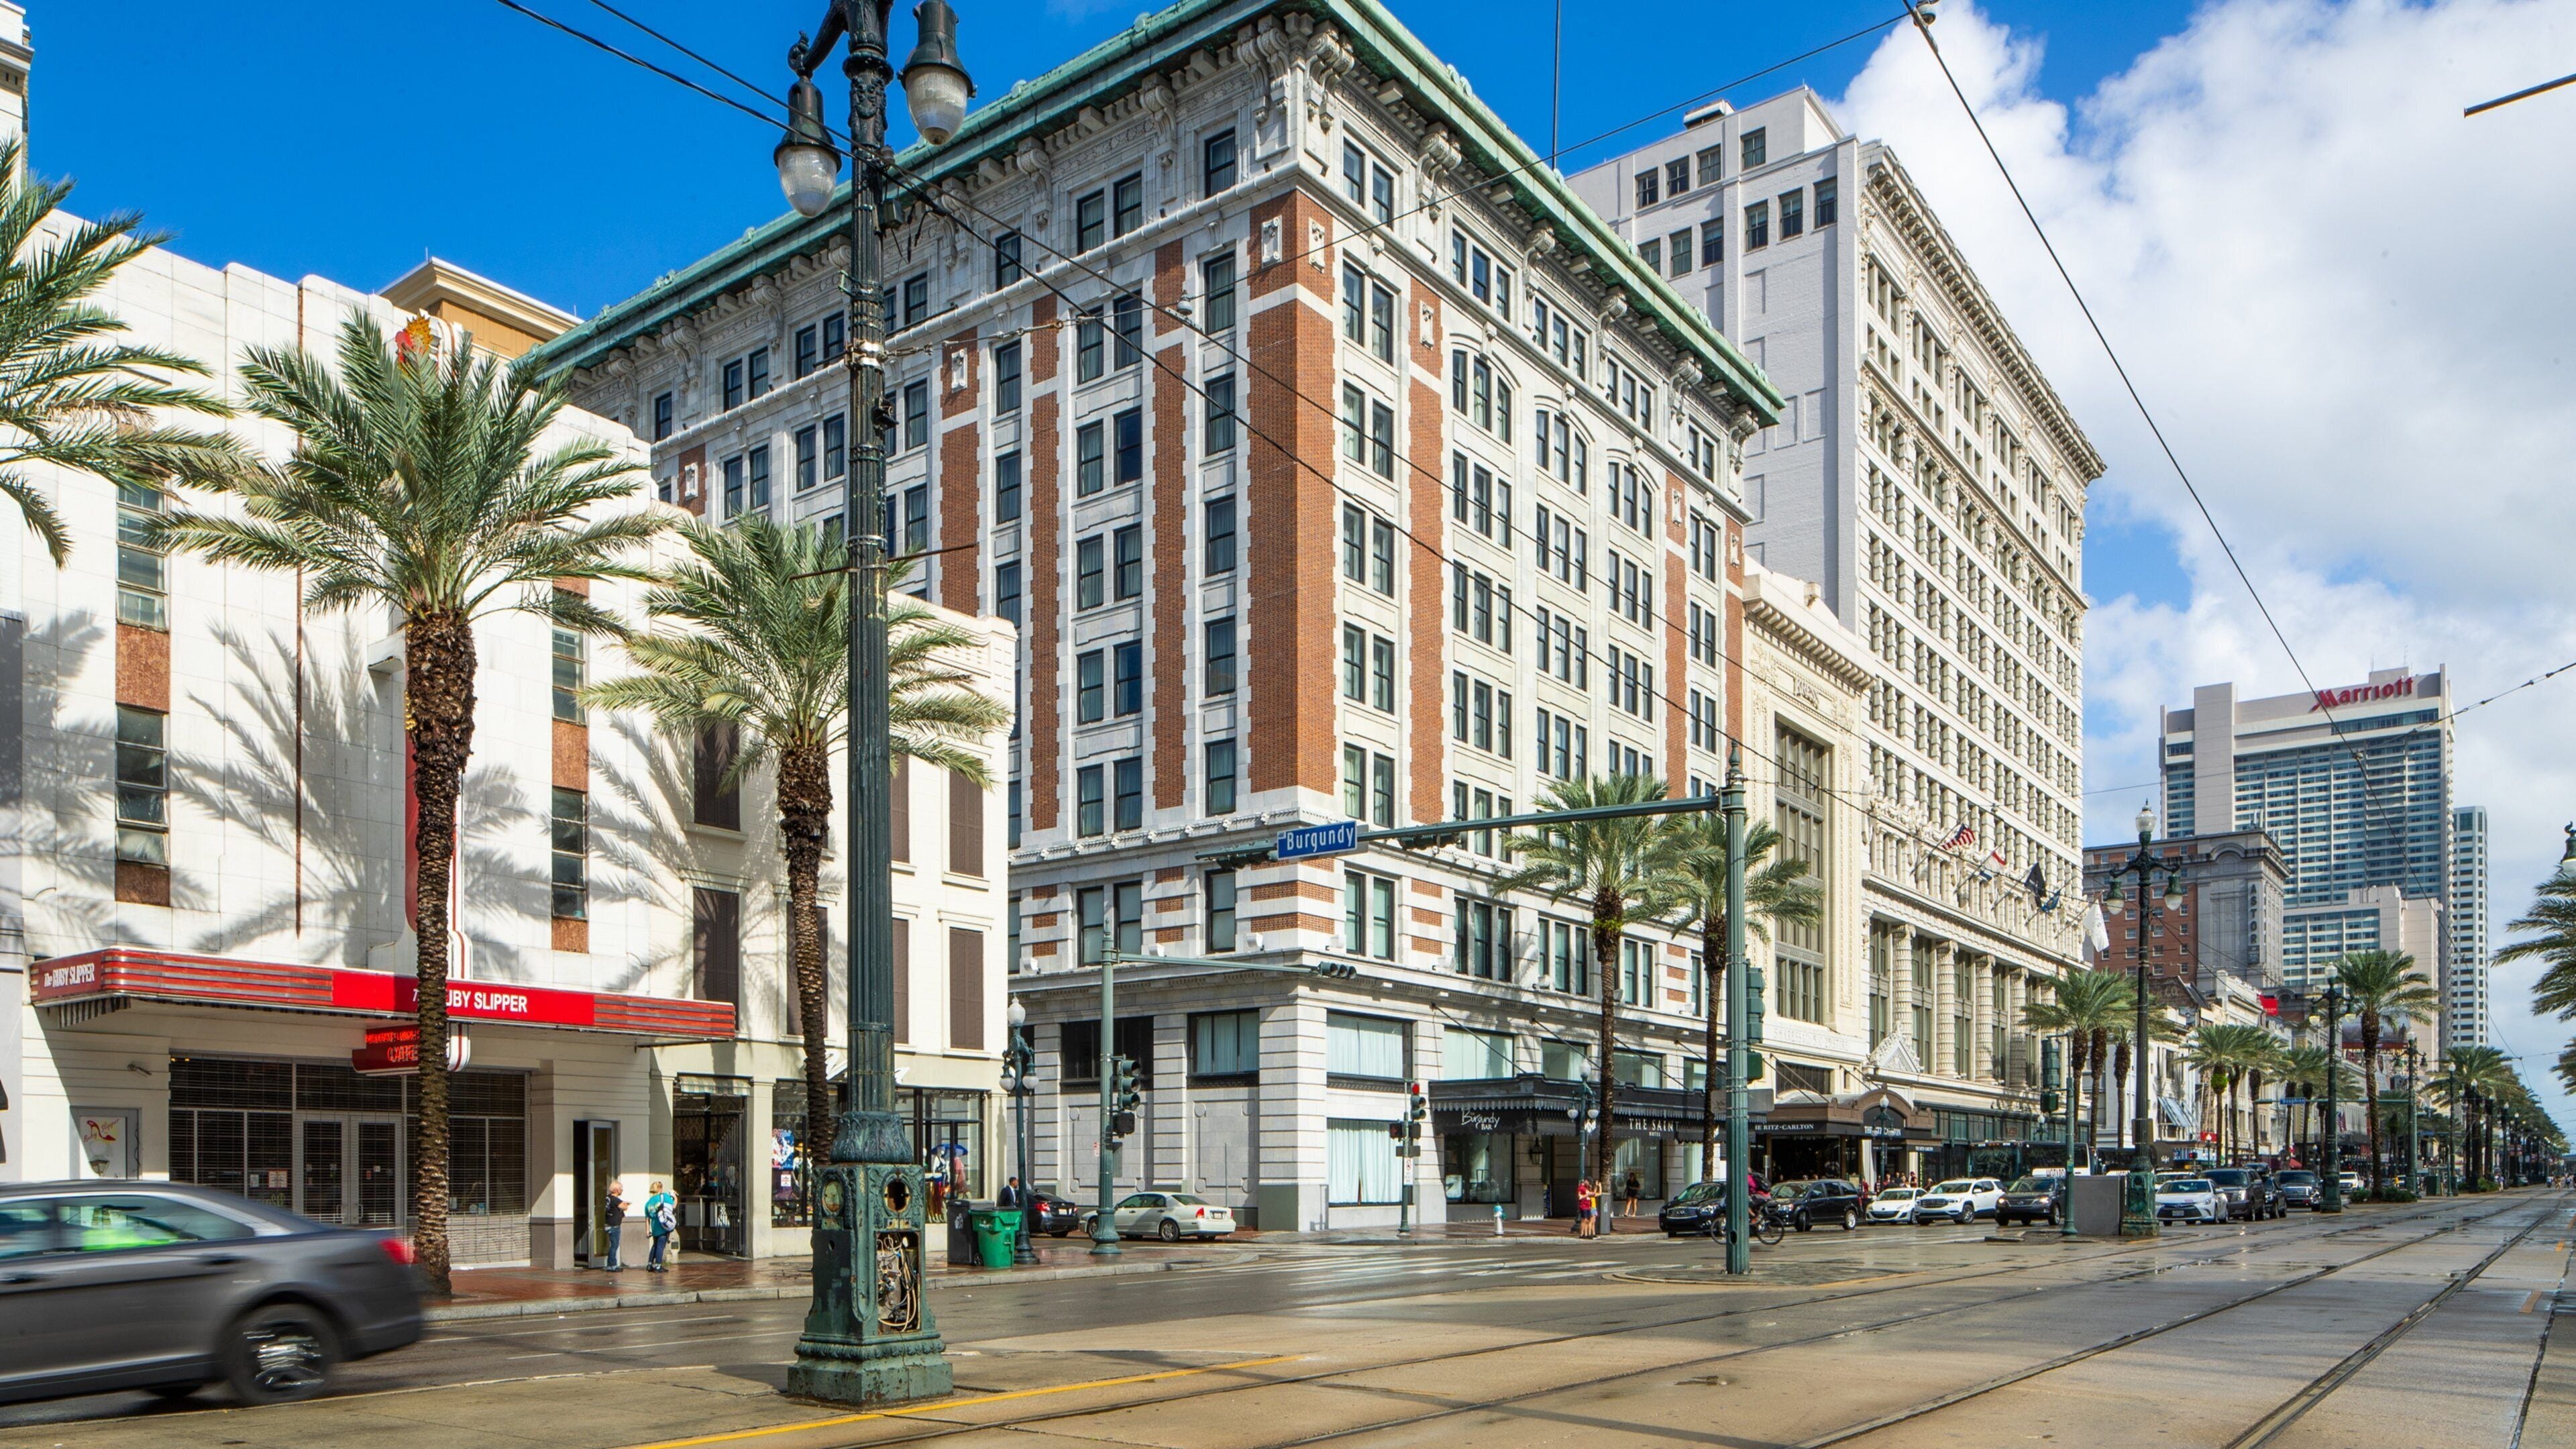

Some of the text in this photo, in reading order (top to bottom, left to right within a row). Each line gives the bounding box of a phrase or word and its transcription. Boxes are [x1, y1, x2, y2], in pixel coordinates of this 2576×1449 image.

[2308, 677, 2414, 712] Marriott
[1287, 825, 1354, 853] Burgundy
[2250, 883, 2258, 944] ASTOR
[44, 963, 95, 987] The RUBY SLIPPER
[445, 989, 527, 1013] UBY SLIPPER
[1461, 1109, 1500, 1129] Burgundy
[1629, 1118, 1680, 1132] THE SAINT
